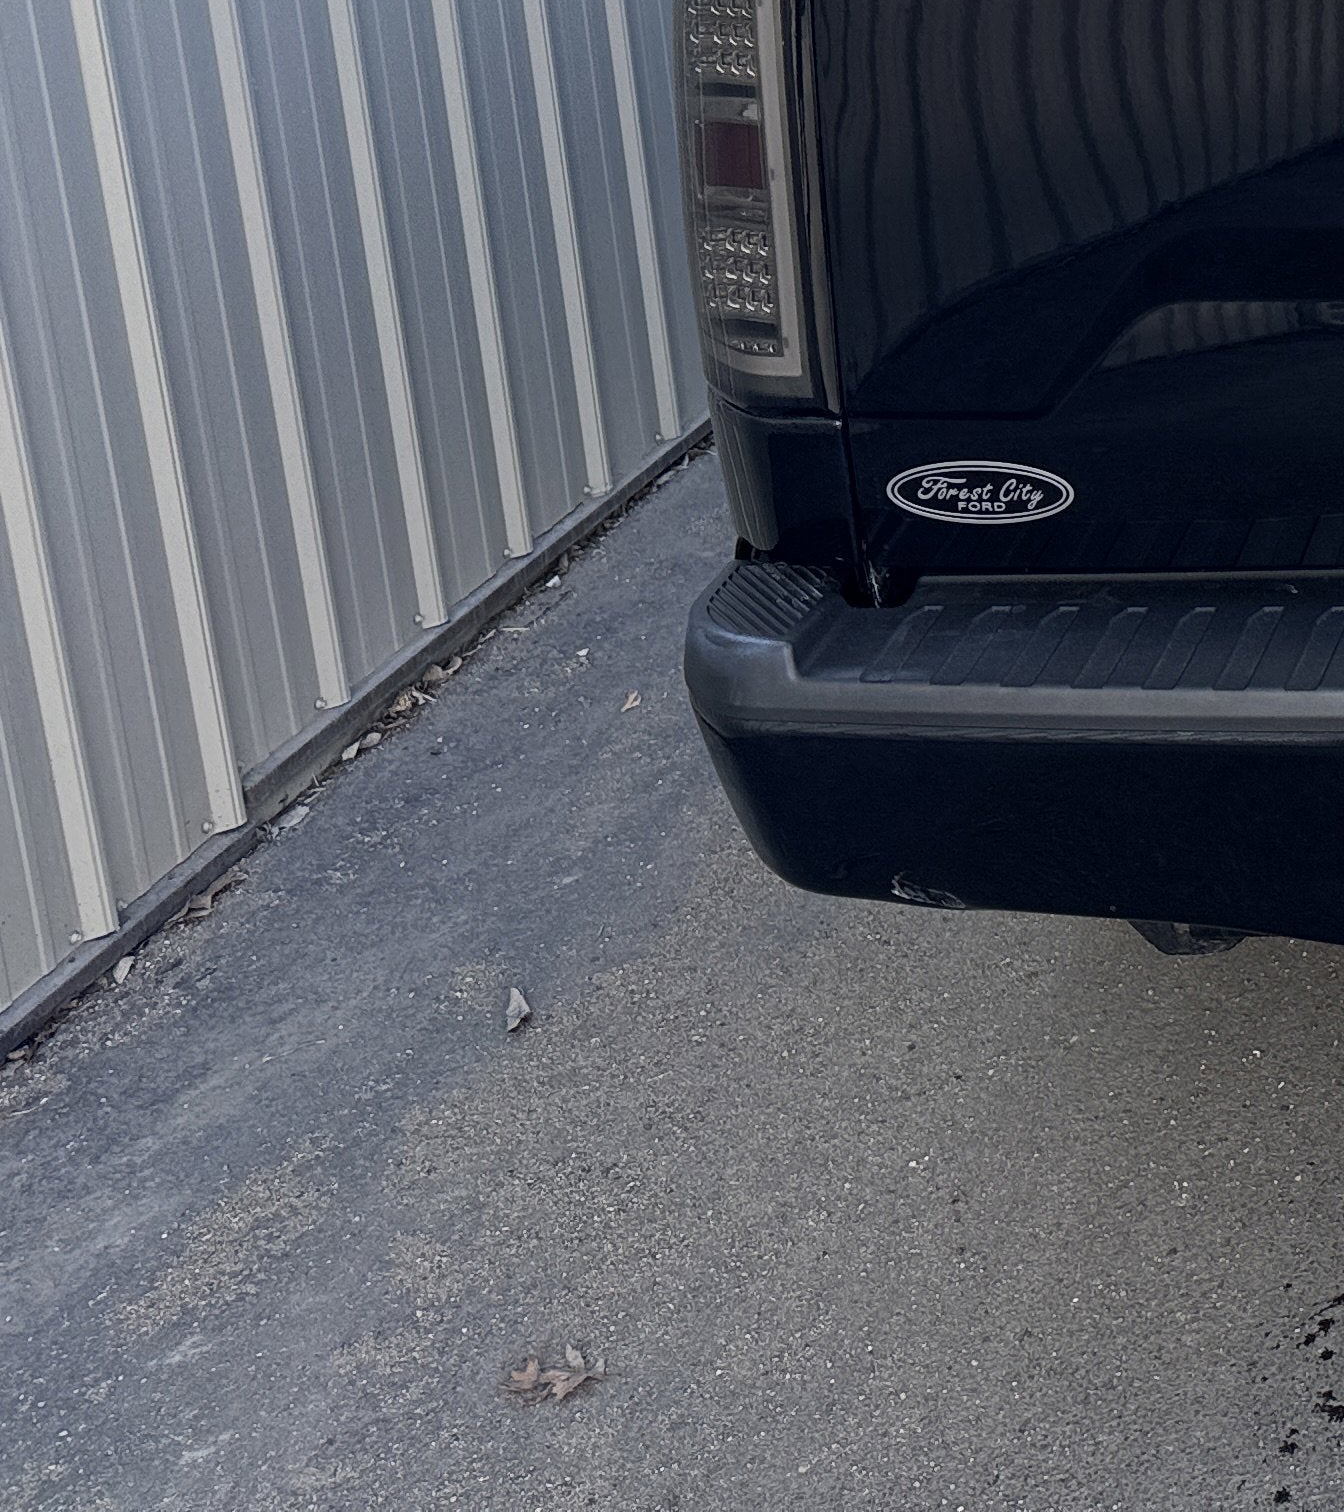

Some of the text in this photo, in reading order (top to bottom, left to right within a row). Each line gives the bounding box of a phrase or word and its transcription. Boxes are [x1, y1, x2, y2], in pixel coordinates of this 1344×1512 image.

[917, 476, 1045, 510] Forest City
[957, 501, 1006, 512] FORD
